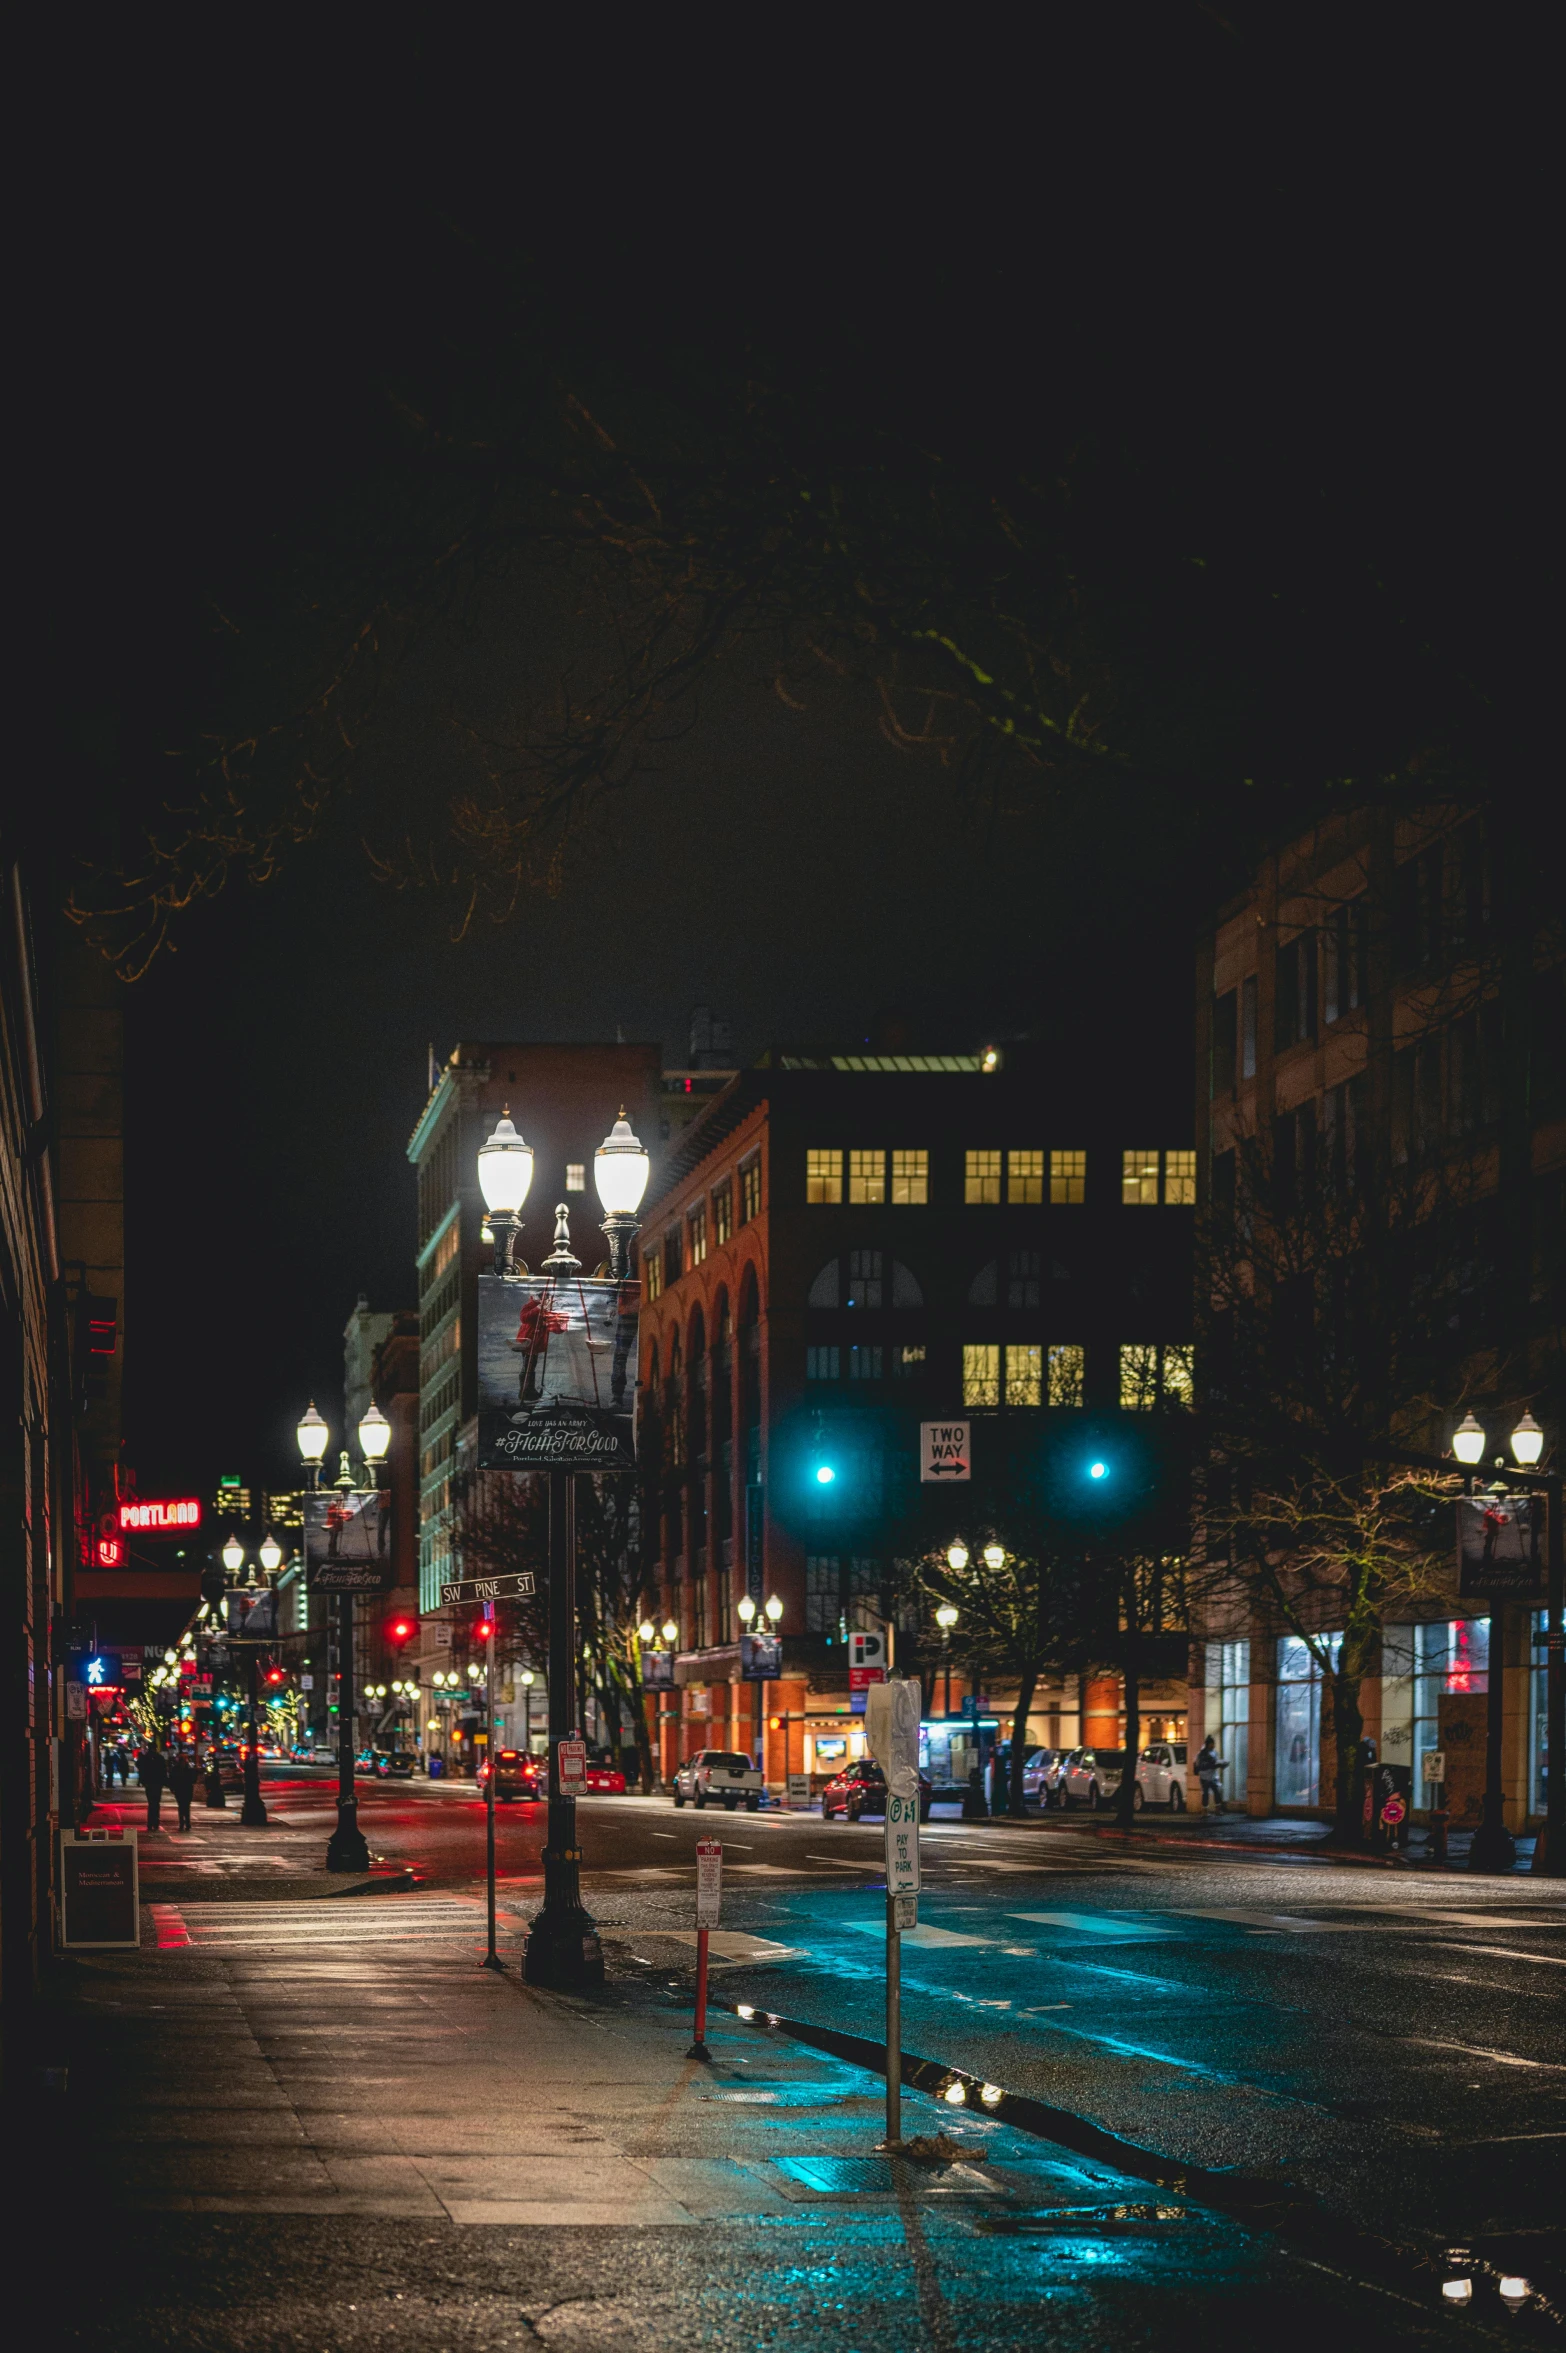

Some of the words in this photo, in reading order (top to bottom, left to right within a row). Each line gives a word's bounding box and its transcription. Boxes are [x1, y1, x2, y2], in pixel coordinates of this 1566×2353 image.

[930, 1427, 964, 1442] TWO
[931, 1444, 963, 1459] WAY
[121, 1502, 199, 1527] PORTLAND
[443, 1586, 461, 1602] SW
[475, 1581, 500, 1598] PINE
[517, 1577, 530, 1592] ST
[896, 1834, 909, 1846] PAY
[704, 1846, 715, 1855] NO
[898, 1847, 908, 1860] TO
[895, 1860, 913, 1873] PARK
